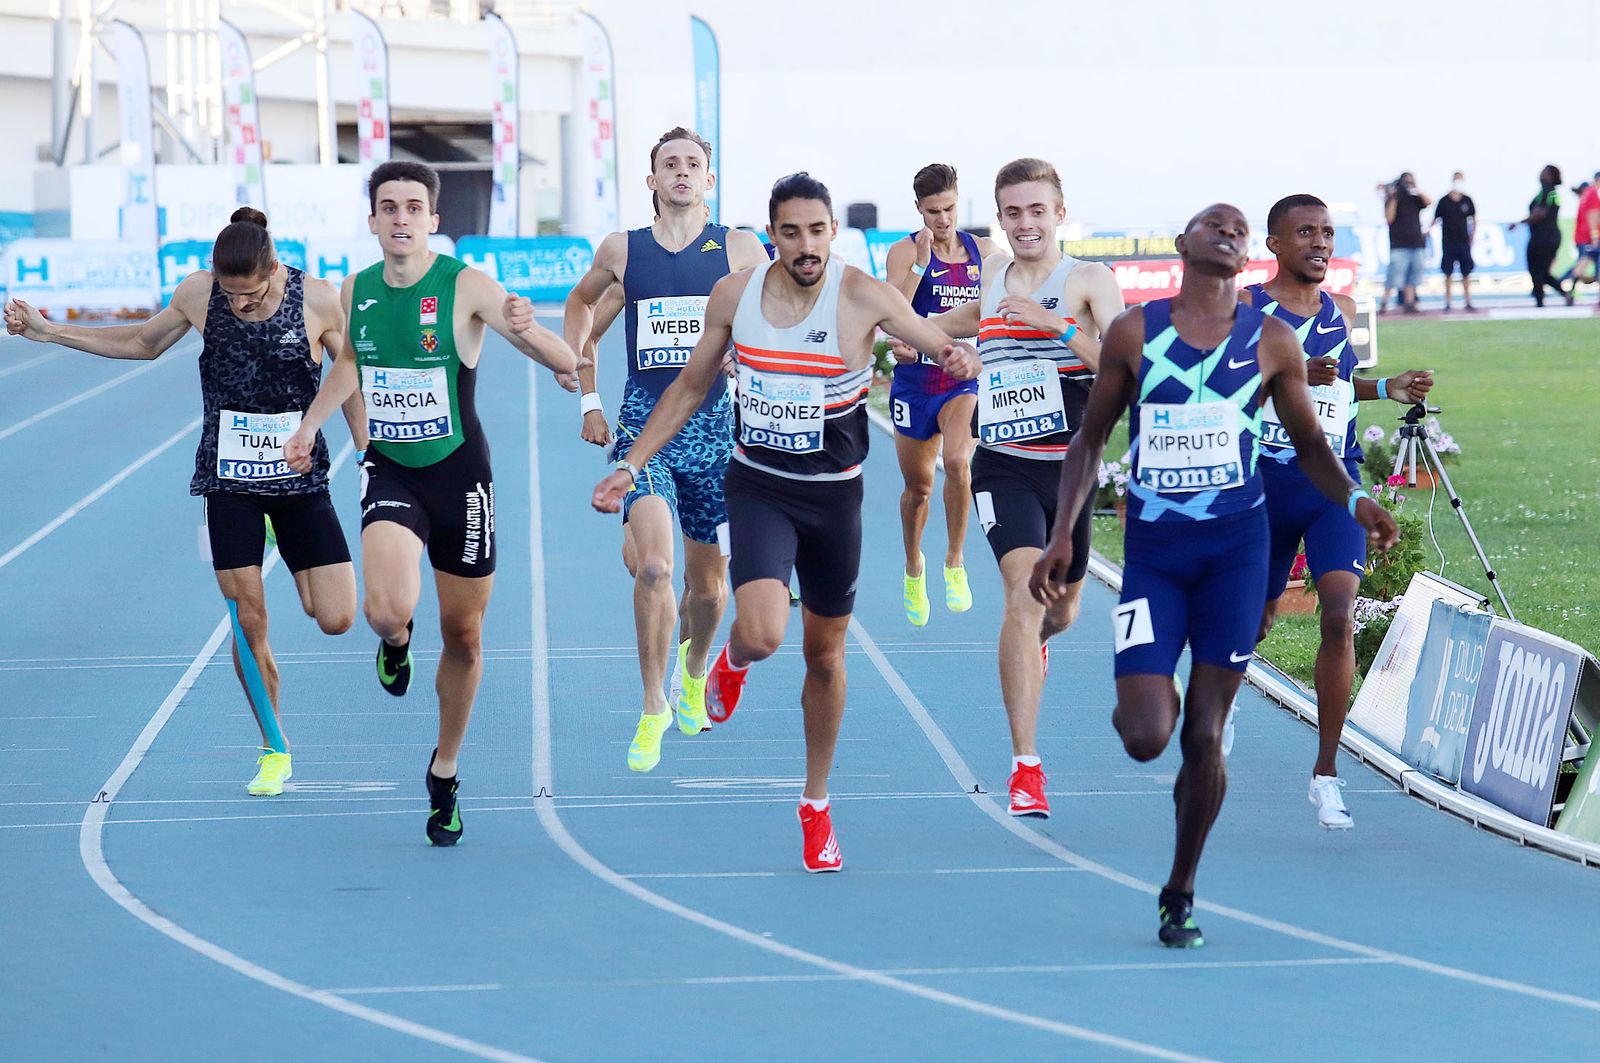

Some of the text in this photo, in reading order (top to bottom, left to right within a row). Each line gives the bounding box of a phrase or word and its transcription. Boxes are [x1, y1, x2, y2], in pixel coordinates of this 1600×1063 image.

[932, 284, 980, 298] FUNDACIÓ
[651, 320, 700, 334] WEBB
[673, 338, 679, 346] 2
[372, 392, 437, 408] GARCIA
[992, 386, 1046, 409] MIRON
[741, 394, 820, 420] ORDOÑEZ
[895, 402, 904, 422] 3
[1014, 408, 1025, 418] 11
[400, 411, 406, 421] 7
[239, 434, 283, 449] TUAL
[1148, 431, 1229, 451] KIPRUTO
[258, 452, 264, 461] 8
[1118, 608, 1136, 640] 7
[1474, 640, 1566, 791] Joma
